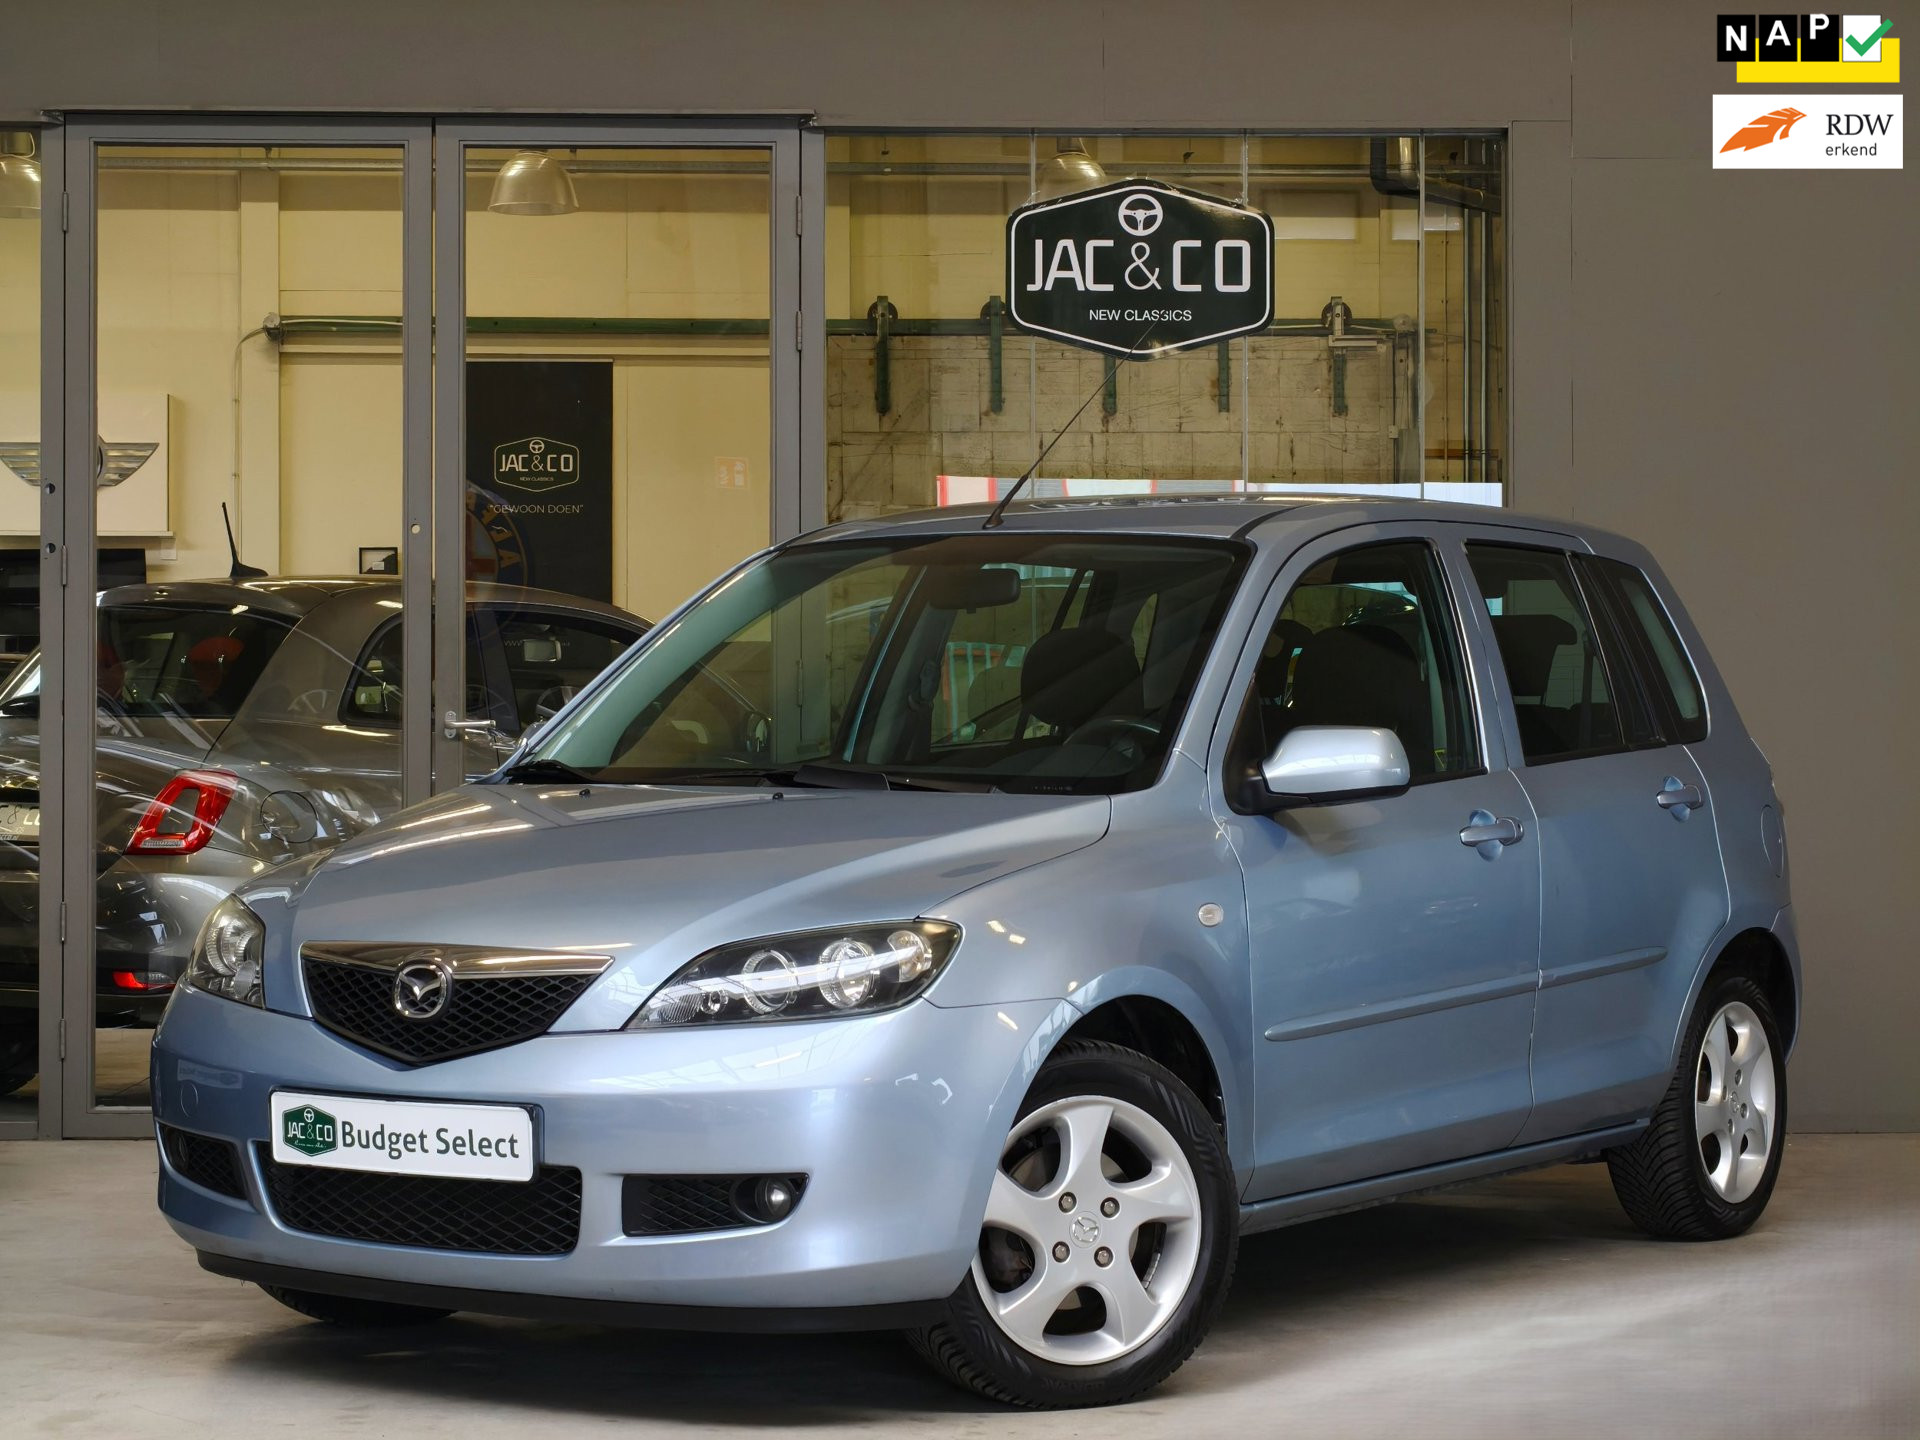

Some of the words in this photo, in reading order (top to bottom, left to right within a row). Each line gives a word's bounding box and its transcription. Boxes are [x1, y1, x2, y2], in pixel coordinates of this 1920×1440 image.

[1026, 238, 1115, 292] JAC
[1124, 241, 1162, 291] &
[1172, 239, 1252, 293] CO
[1089, 309, 1121, 321] NEW
[1124, 309, 1193, 322] CLASSICS
[499, 453, 529, 472] JAC
[546, 453, 574, 473] CO
[287, 1121, 305, 1139] JAC
[316, 1124, 334, 1142] CO
[341, 1120, 429, 1160] Budget
[436, 1127, 520, 1159] Select
